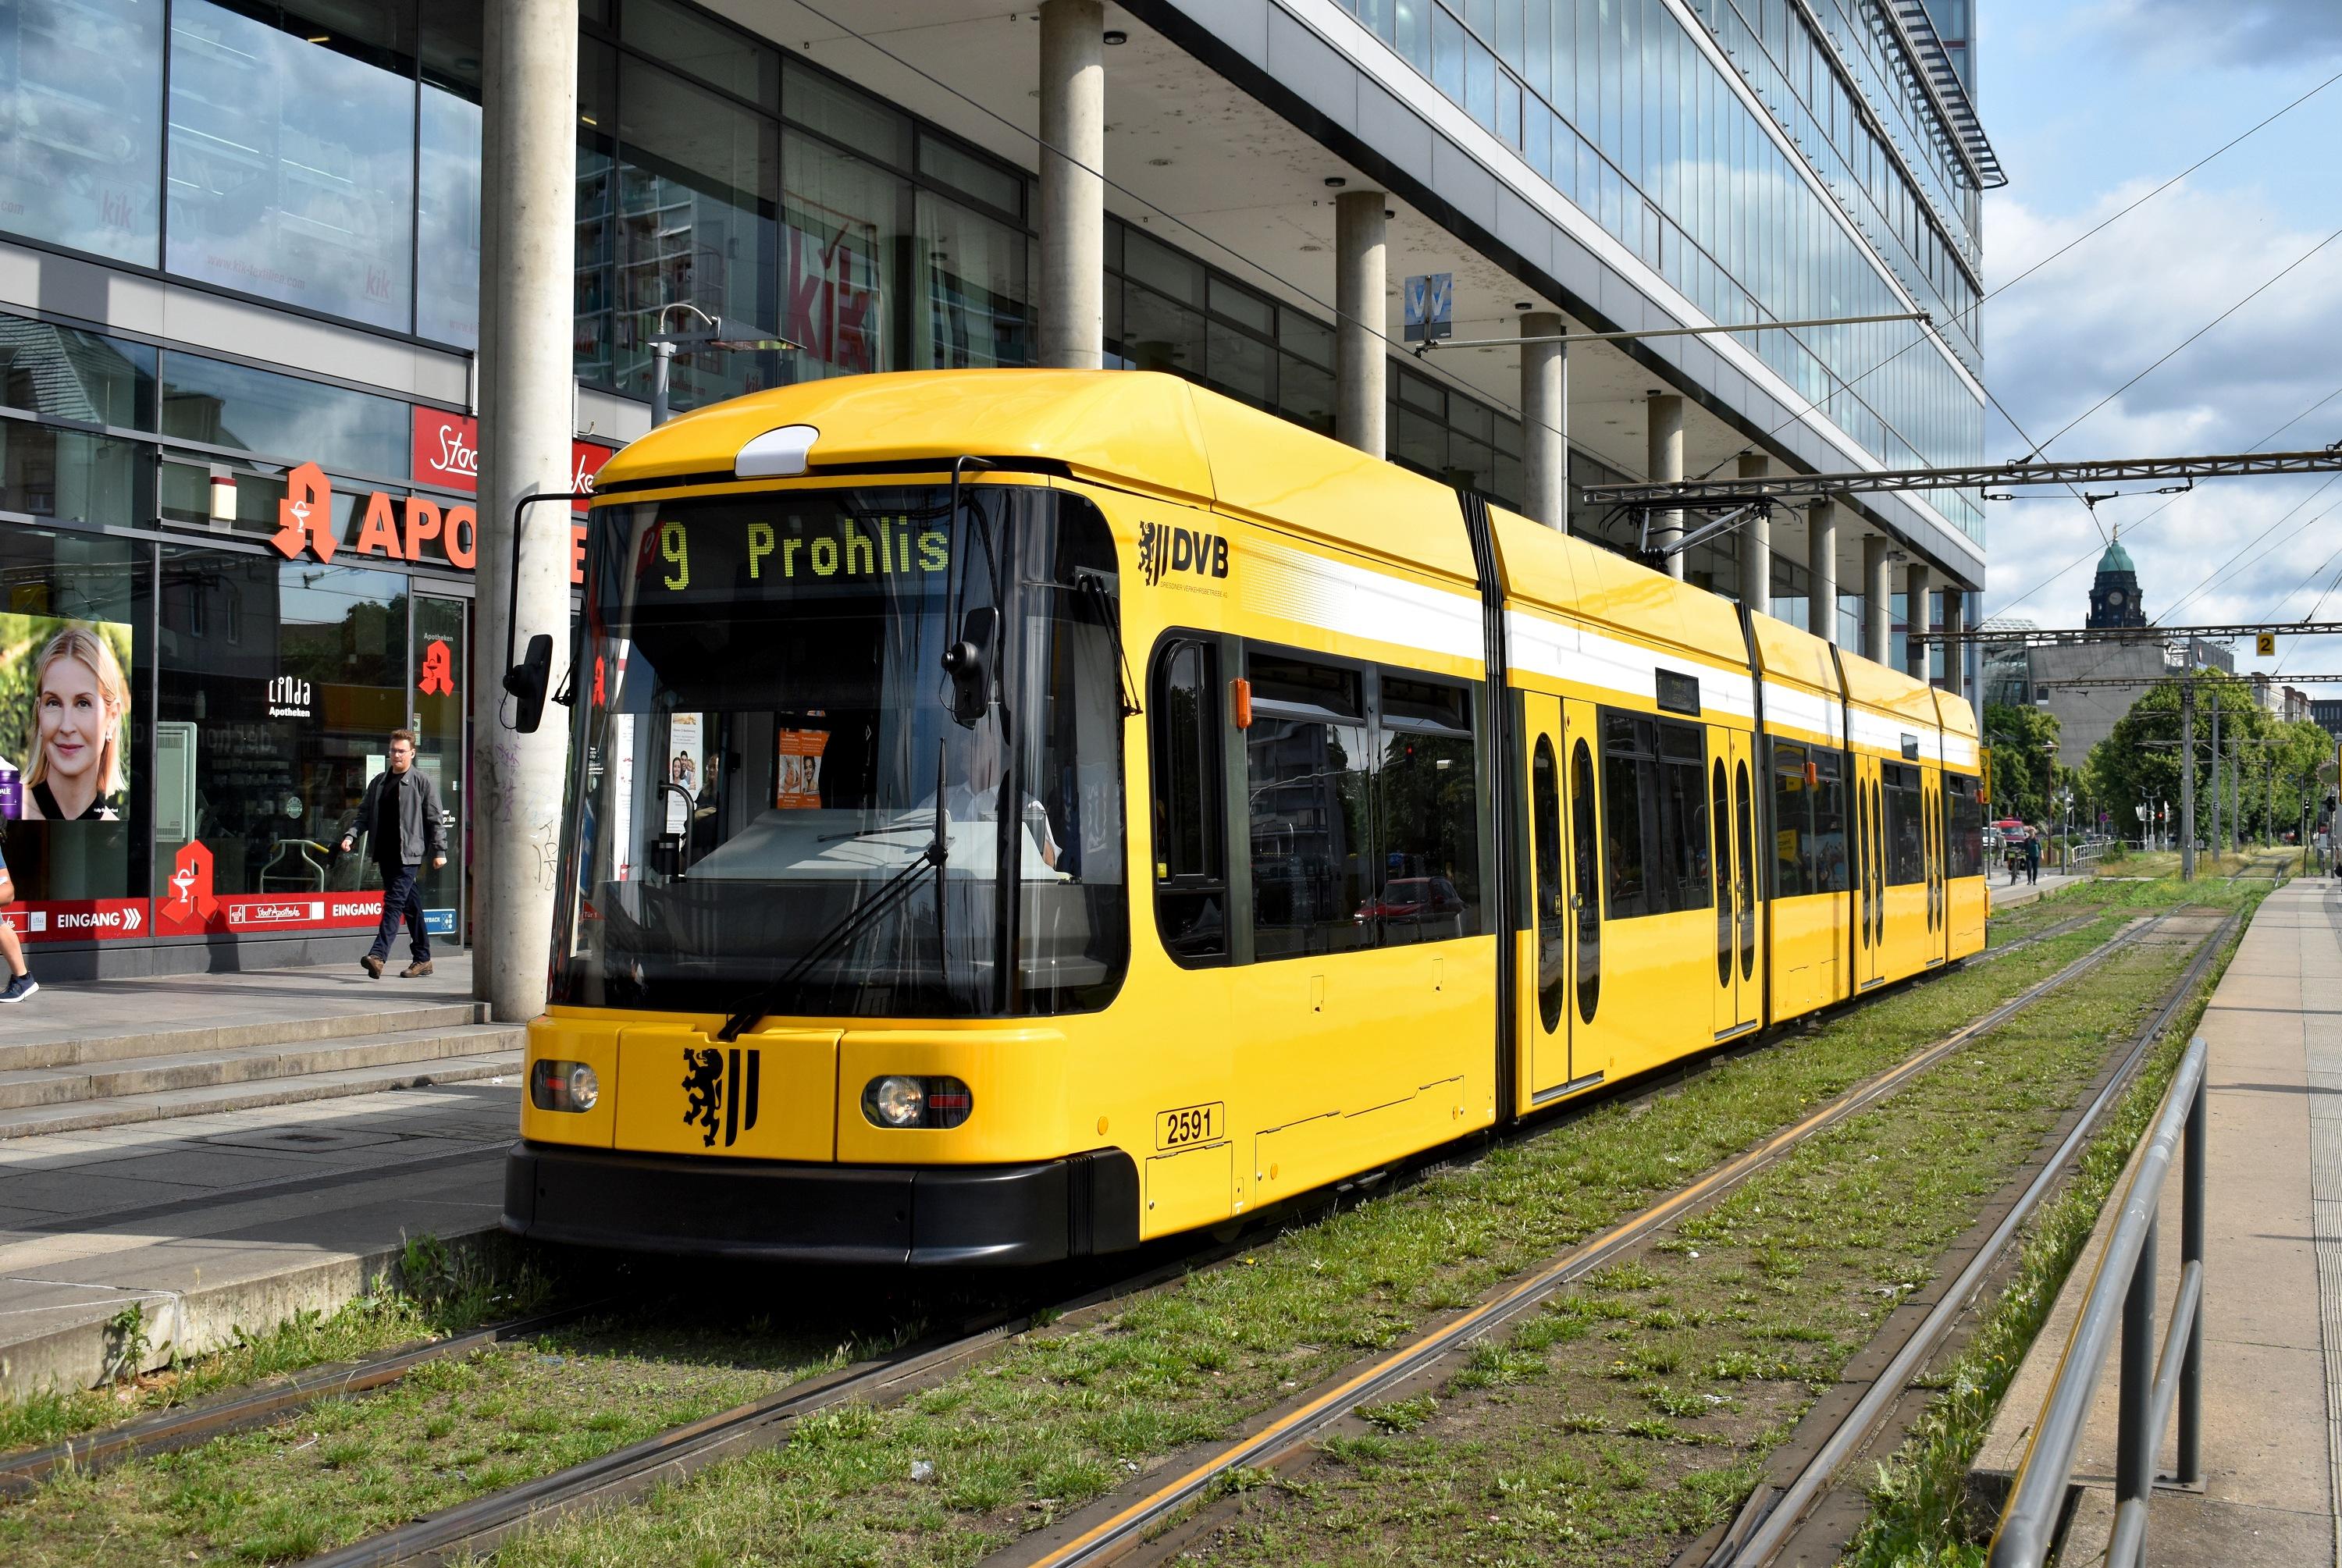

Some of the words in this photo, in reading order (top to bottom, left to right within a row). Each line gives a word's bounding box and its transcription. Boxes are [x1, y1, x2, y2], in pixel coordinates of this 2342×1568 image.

[661, 521, 689, 590] 9
[748, 515, 949, 578] Prohlis
[1171, 527, 1229, 579] DVB
[424, 633, 454, 642] Apotheken
[2260, 638, 2271, 652] 2
[269, 706, 311, 717] Apotheken
[2212, 802, 2218, 810] E
[332, 902, 382, 917] EINGANG
[57, 912, 121, 928] EINGANG
[1167, 1108, 1211, 1145] 2591
